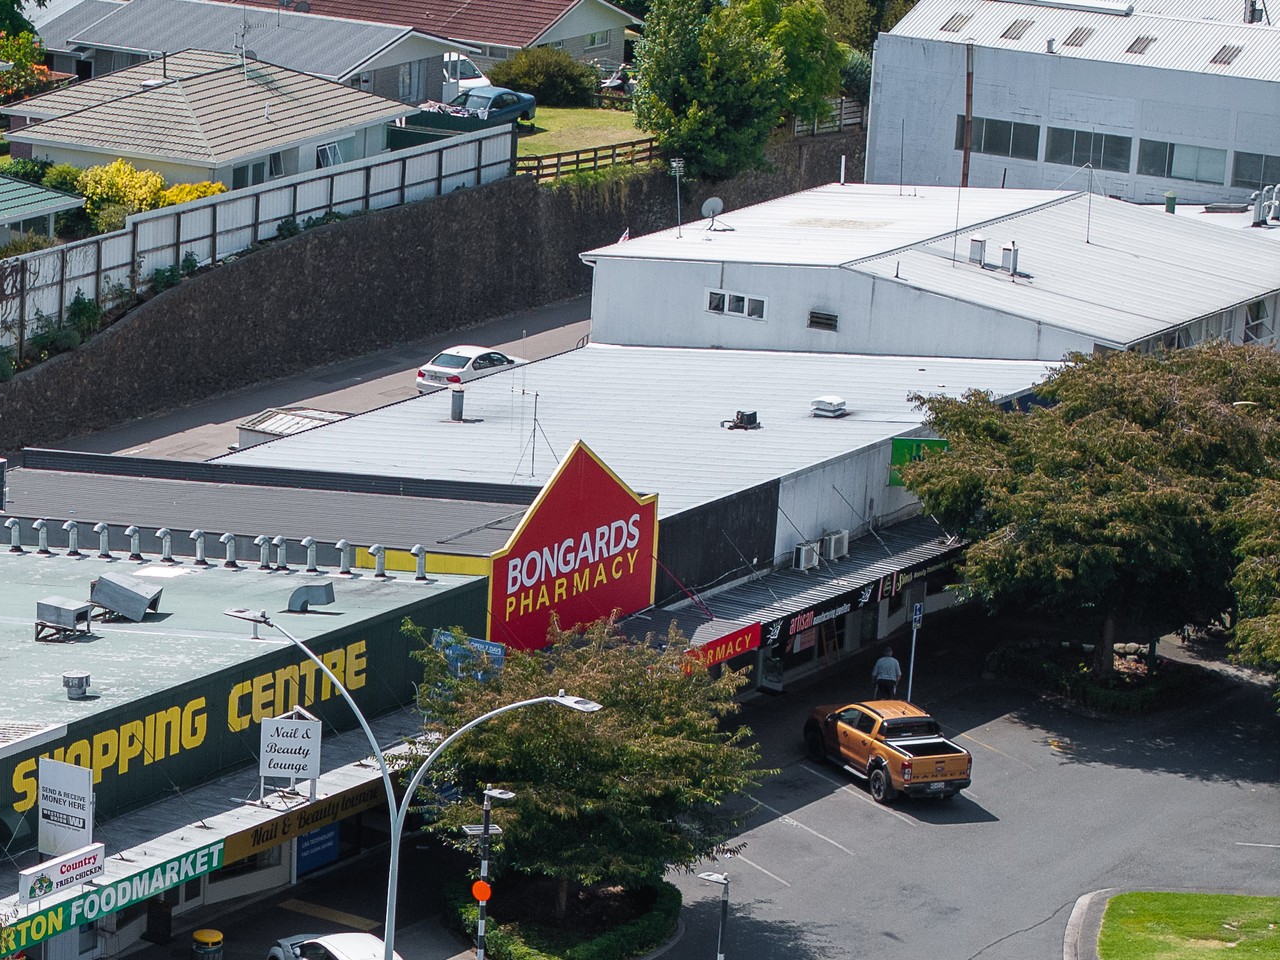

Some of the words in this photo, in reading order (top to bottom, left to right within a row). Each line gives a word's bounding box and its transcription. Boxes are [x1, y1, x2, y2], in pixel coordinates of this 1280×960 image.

[507, 513, 640, 595] BONGARDS
[505, 549, 639, 622] PHARMACY
[789, 610, 815, 636] artisan
[12, 696, 207, 813] SOPPING
[227, 639, 366, 732] CENTRE
[270, 726, 298, 739] Nail
[301, 727, 312, 739] &
[265, 743, 311, 758] Beauty
[268, 758, 308, 774] lounge
[913, 771, 966, 780] RANGER
[41, 786, 57, 795] SEND
[63, 791, 86, 803] RECEIVE
[41, 793, 67, 807] MONEY
[68, 802, 86, 812] HERE
[43, 809, 67, 818] WESTERN
[69, 816, 83, 828] WU
[251, 823, 278, 848] Nail
[281, 817, 292, 836] &
[296, 803, 339, 830] Beauty
[341, 786, 380, 812] lounge
[59, 853, 98, 876] Country
[56, 876, 75, 889] FRIED
[75, 864, 103, 884] CHICKEN
[70, 842, 224, 926] FOODMARKET
